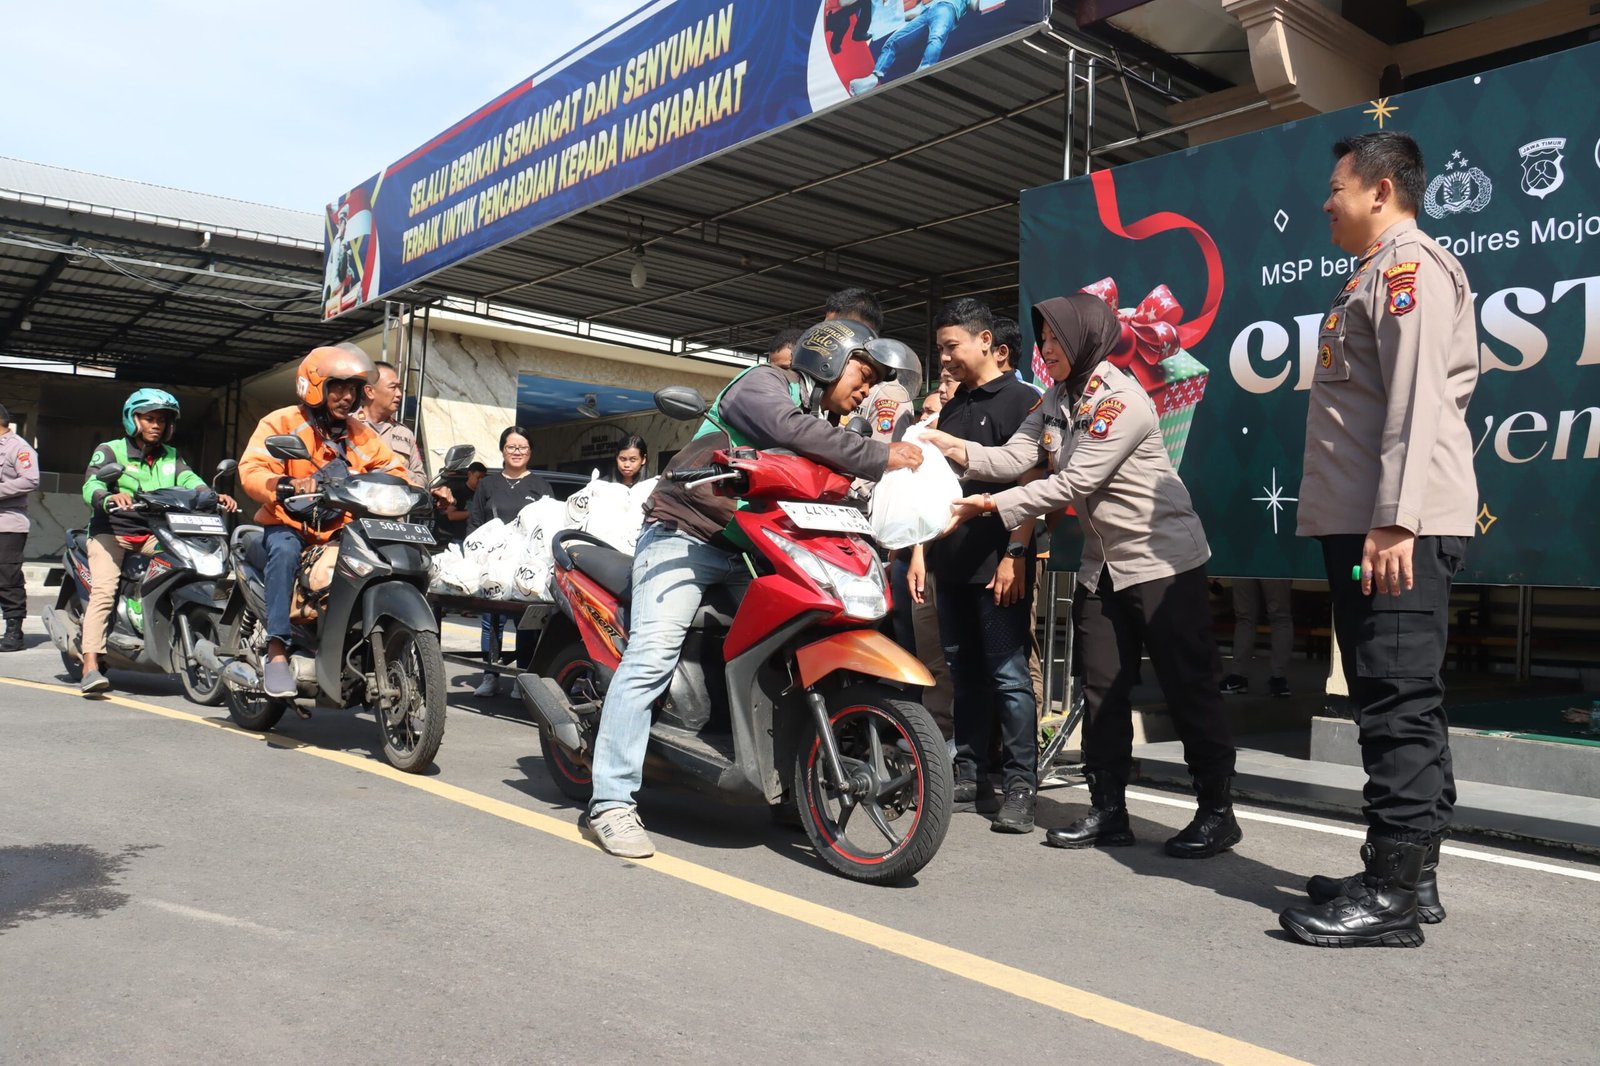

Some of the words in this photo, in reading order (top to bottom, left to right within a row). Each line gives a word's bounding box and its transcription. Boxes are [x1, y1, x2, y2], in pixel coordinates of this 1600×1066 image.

[409, 164, 450, 218] SELALU
[448, 133, 502, 196] BERIKAN
[502, 88, 582, 168] SEMANGAT
[582, 66, 621, 126] DAN
[622, 3, 734, 104] SENYUMAN
[402, 213, 442, 264] TERBAIK
[441, 194, 478, 246] UNTUK
[477, 154, 557, 230] PENGABDIAN
[558, 124, 618, 192] KEPADA
[621, 60, 748, 163] MASYARAKAT
[1522, 143, 1541, 153] JAWA
[1262, 259, 1313, 286] MSP
[1321, 254, 1358, 278] ber
[1531, 212, 1600, 245] Mojo
[363, 520, 372, 528] S
[380, 521, 407, 532] 5036
